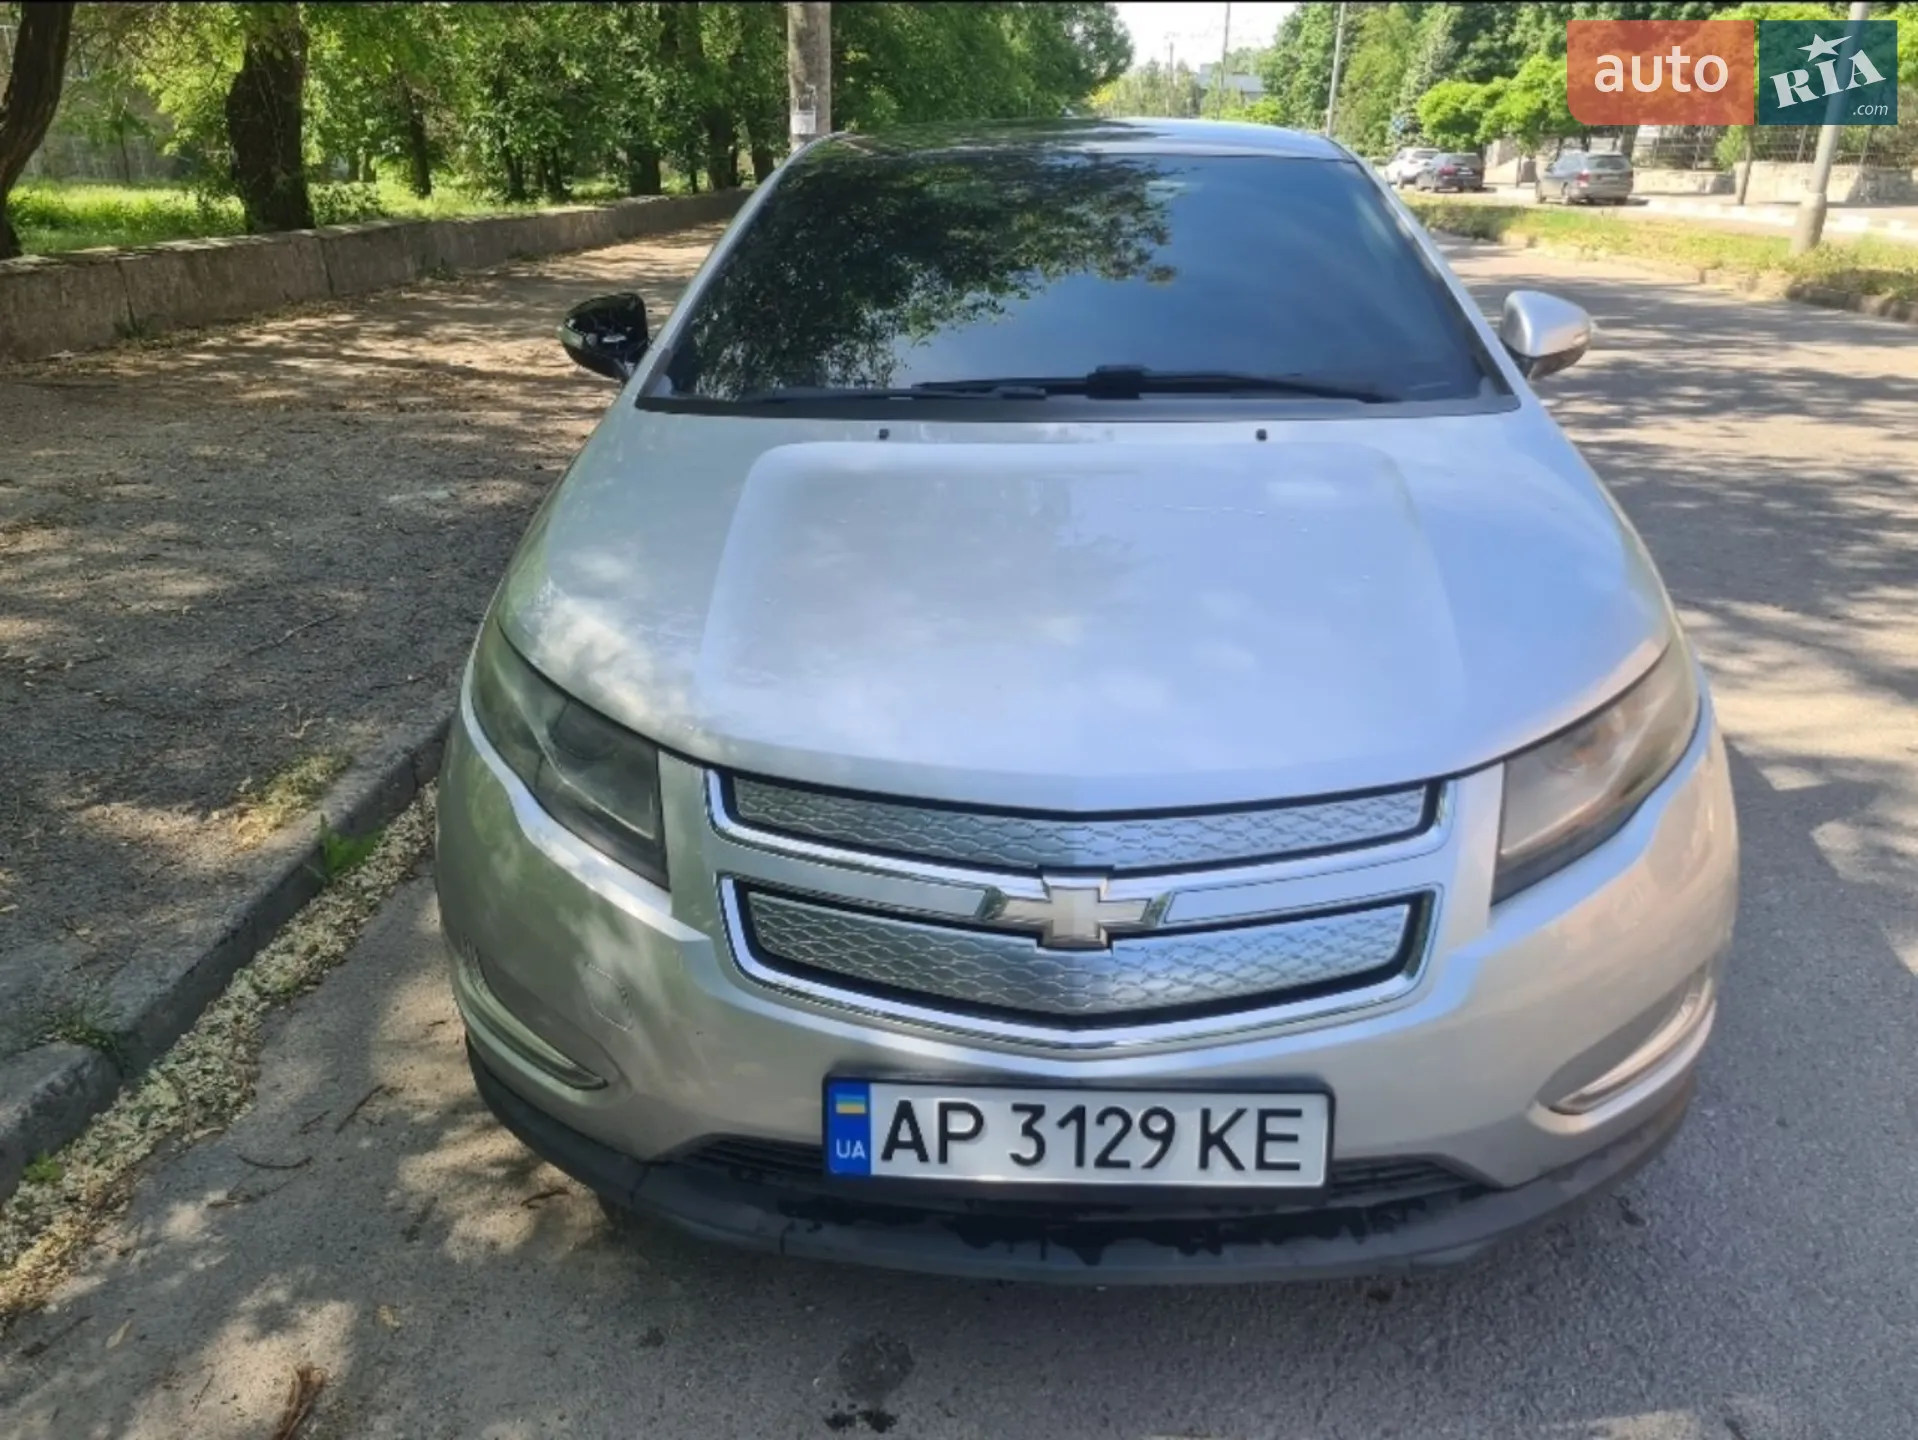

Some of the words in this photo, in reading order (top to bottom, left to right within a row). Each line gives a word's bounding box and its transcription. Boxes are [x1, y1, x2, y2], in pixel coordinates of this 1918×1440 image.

[836, 1140, 866, 1160] UA
[881, 1099, 984, 1164] AP
[1009, 1102, 1176, 1169] 3129
[1200, 1107, 1303, 1171] KE
